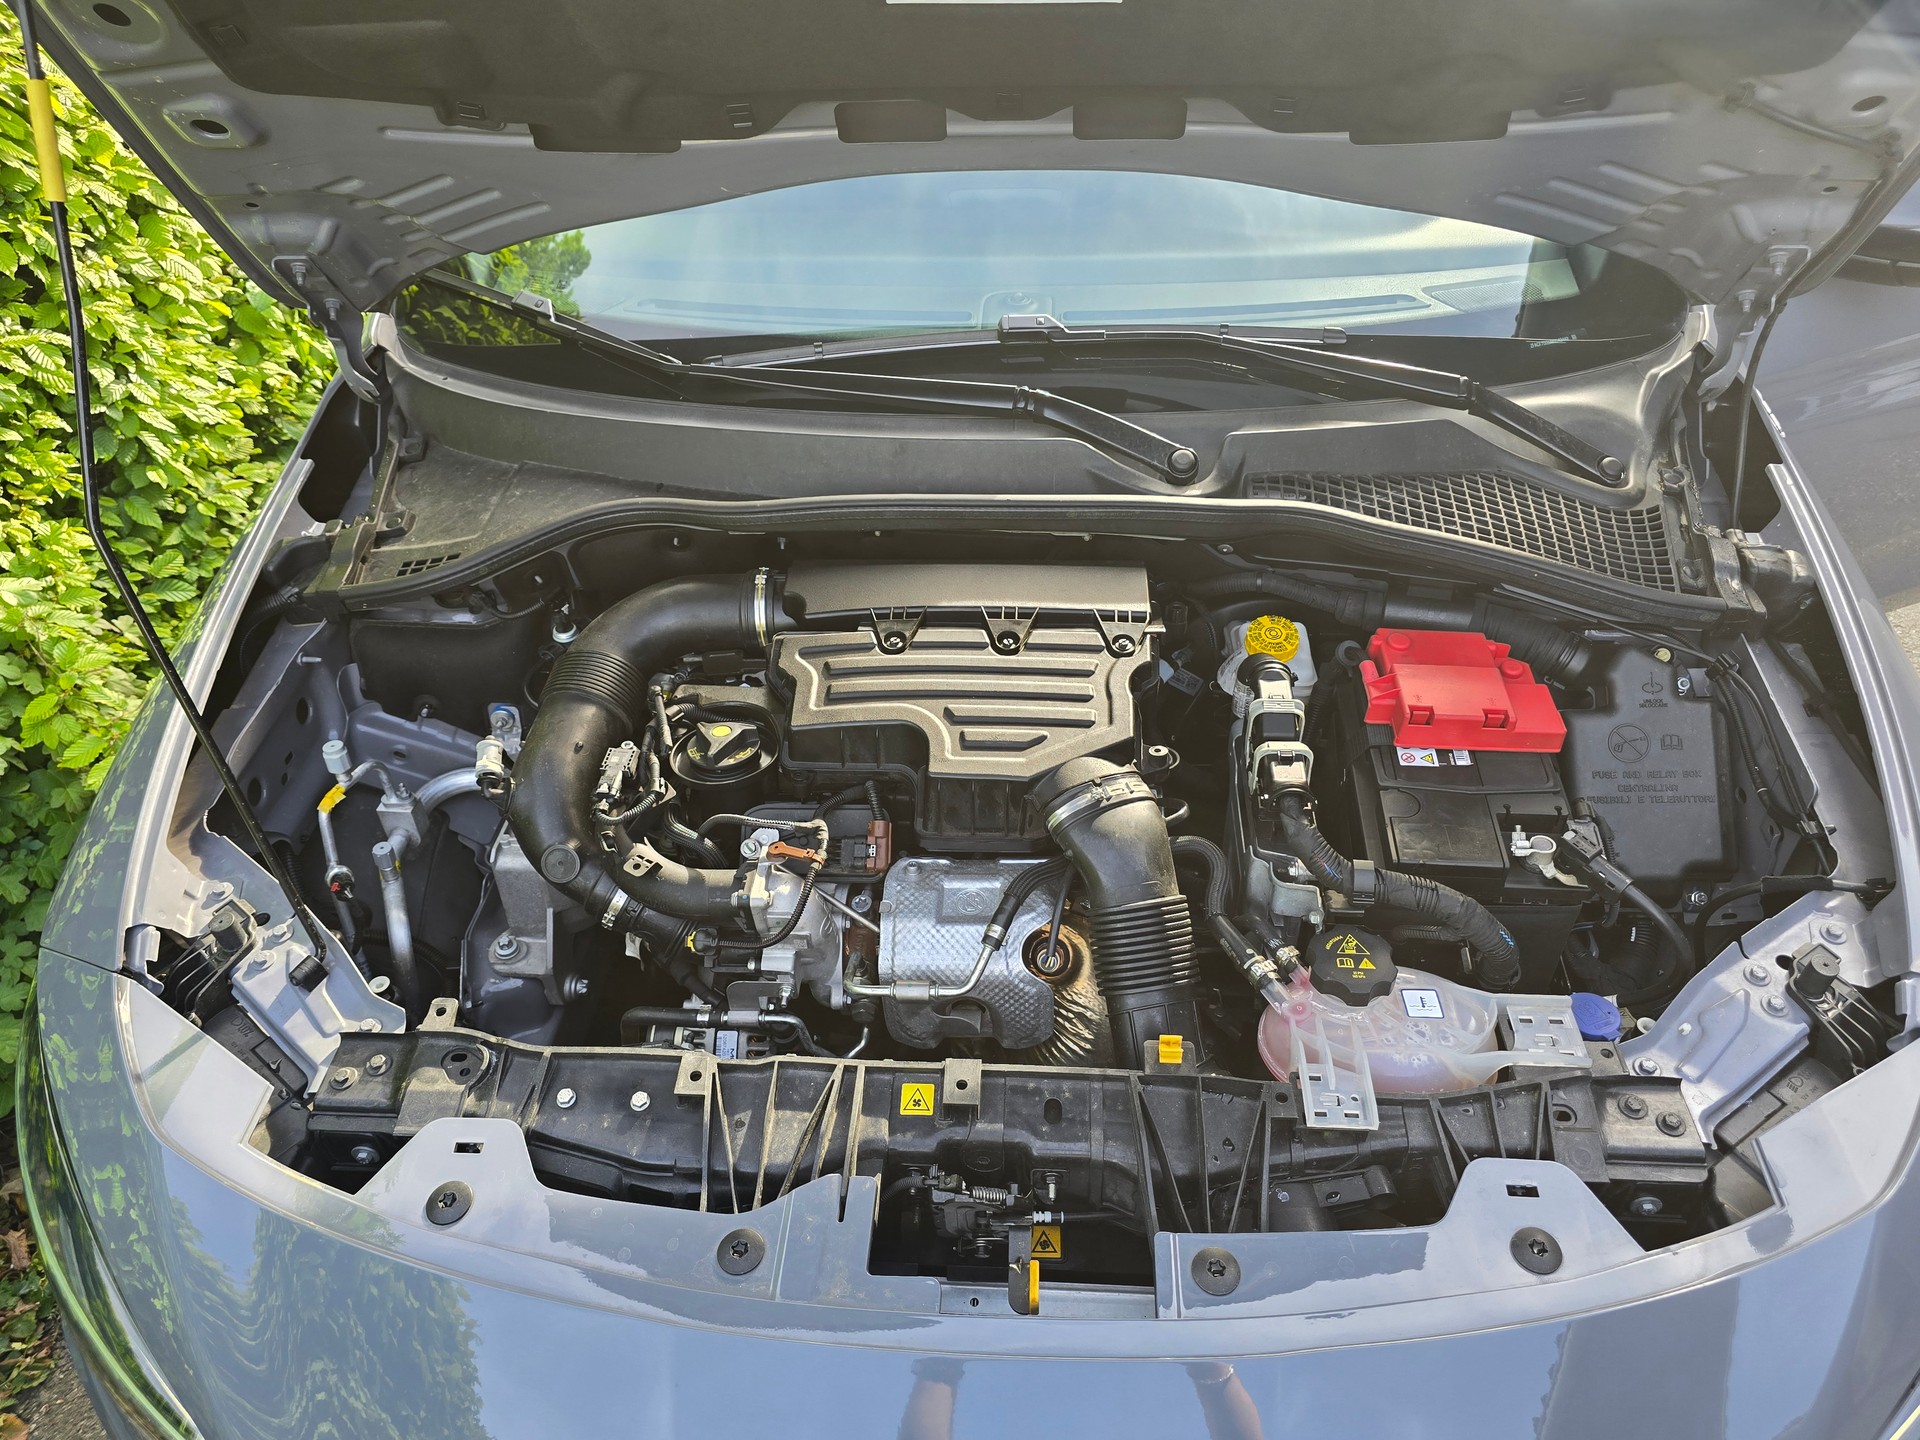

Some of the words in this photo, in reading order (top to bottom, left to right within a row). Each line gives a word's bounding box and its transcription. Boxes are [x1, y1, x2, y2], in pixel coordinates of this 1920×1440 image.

[1591, 770, 1618, 780] FUSE
[1622, 770, 1642, 779] AND
[1646, 770, 1679, 779] RELAY
[1682, 769, 1703, 778] BOX
[1617, 783, 1679, 793] CENTRALINA
[1586, 795, 1632, 805] FUSIBILI
[1637, 795, 1645, 804] E
[1650, 794, 1716, 804] TELERUTTORI
